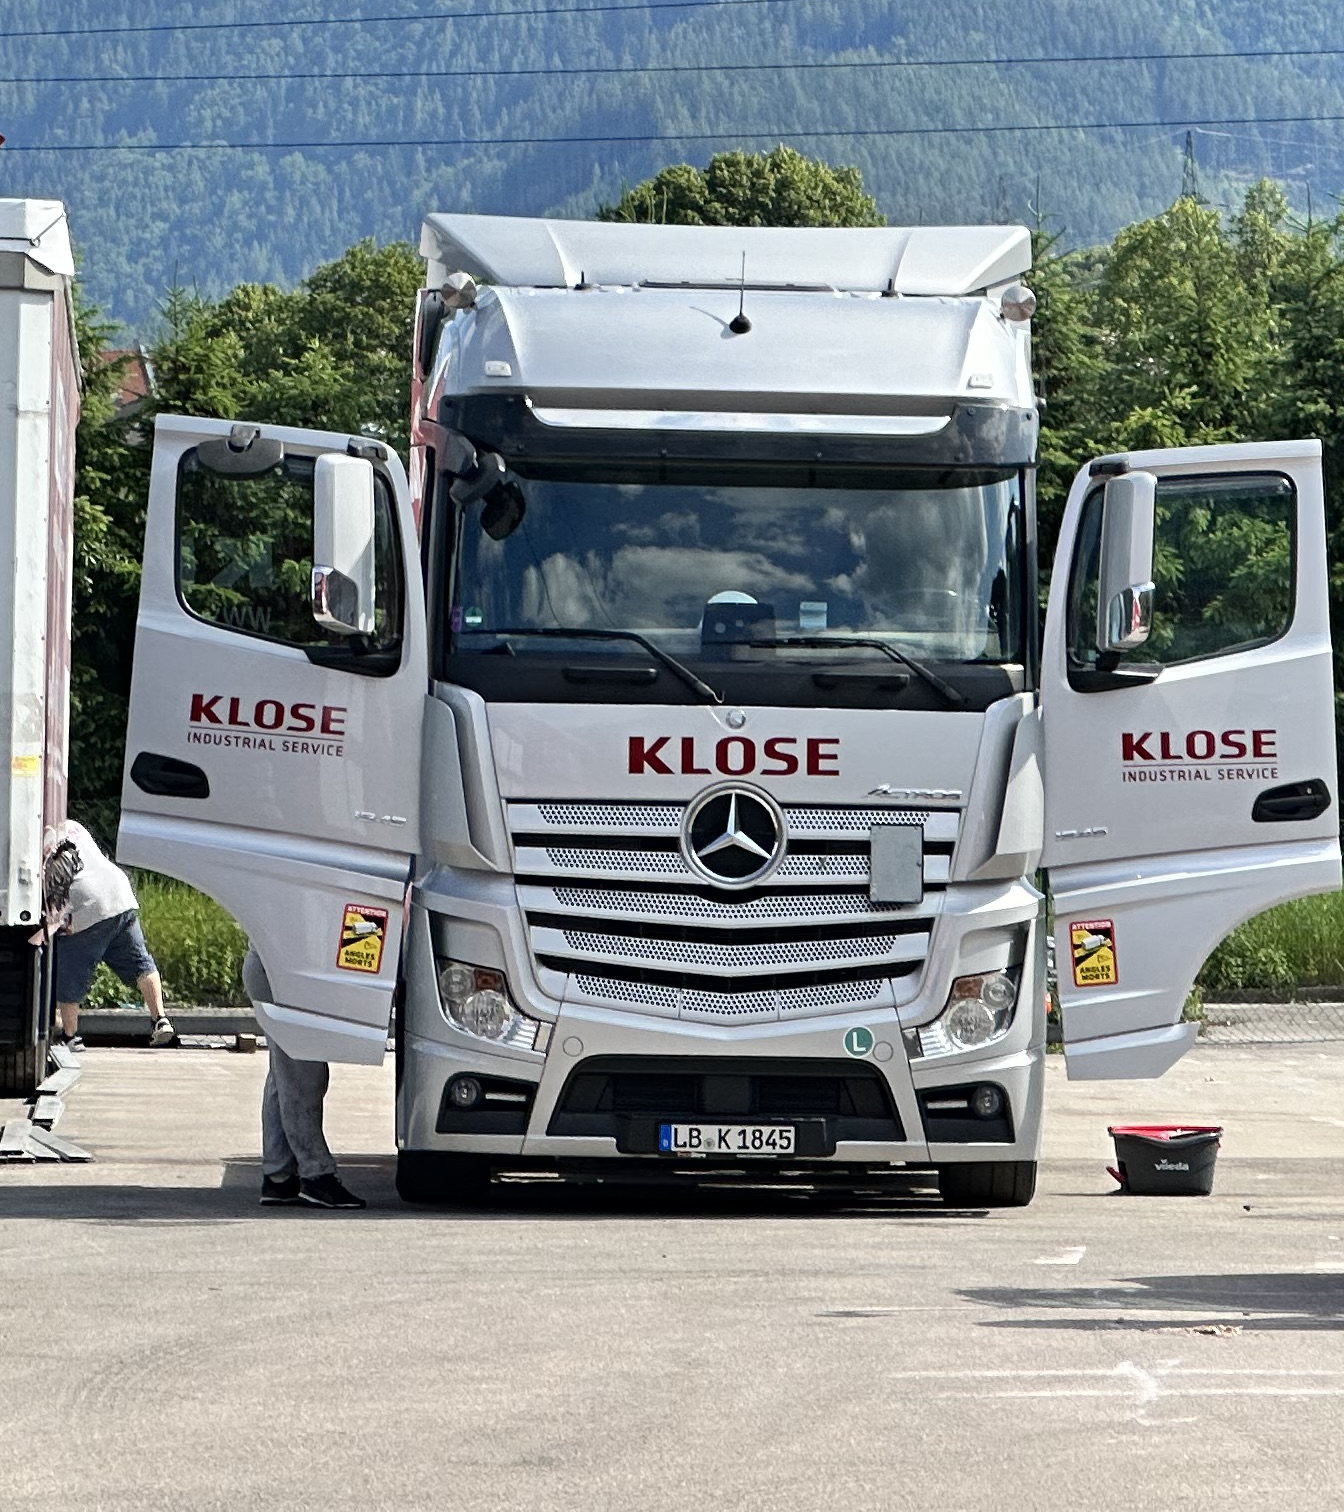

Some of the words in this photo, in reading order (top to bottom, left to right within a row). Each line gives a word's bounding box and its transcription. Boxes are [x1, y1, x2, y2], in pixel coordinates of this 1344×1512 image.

[189, 693, 348, 736] KLOSE
[187, 731, 276, 751] INDUSTRIAL
[282, 740, 344, 757] SERVICE
[628, 735, 841, 777] KLOSE
[1121, 729, 1278, 761] KLOSE
[1122, 769, 1212, 783] INDUSTRIAL
[1217, 767, 1279, 781] SERVICE
[673, 1127, 702, 1148] LB
[717, 1128, 731, 1150] K
[737, 1128, 792, 1150] 1845
